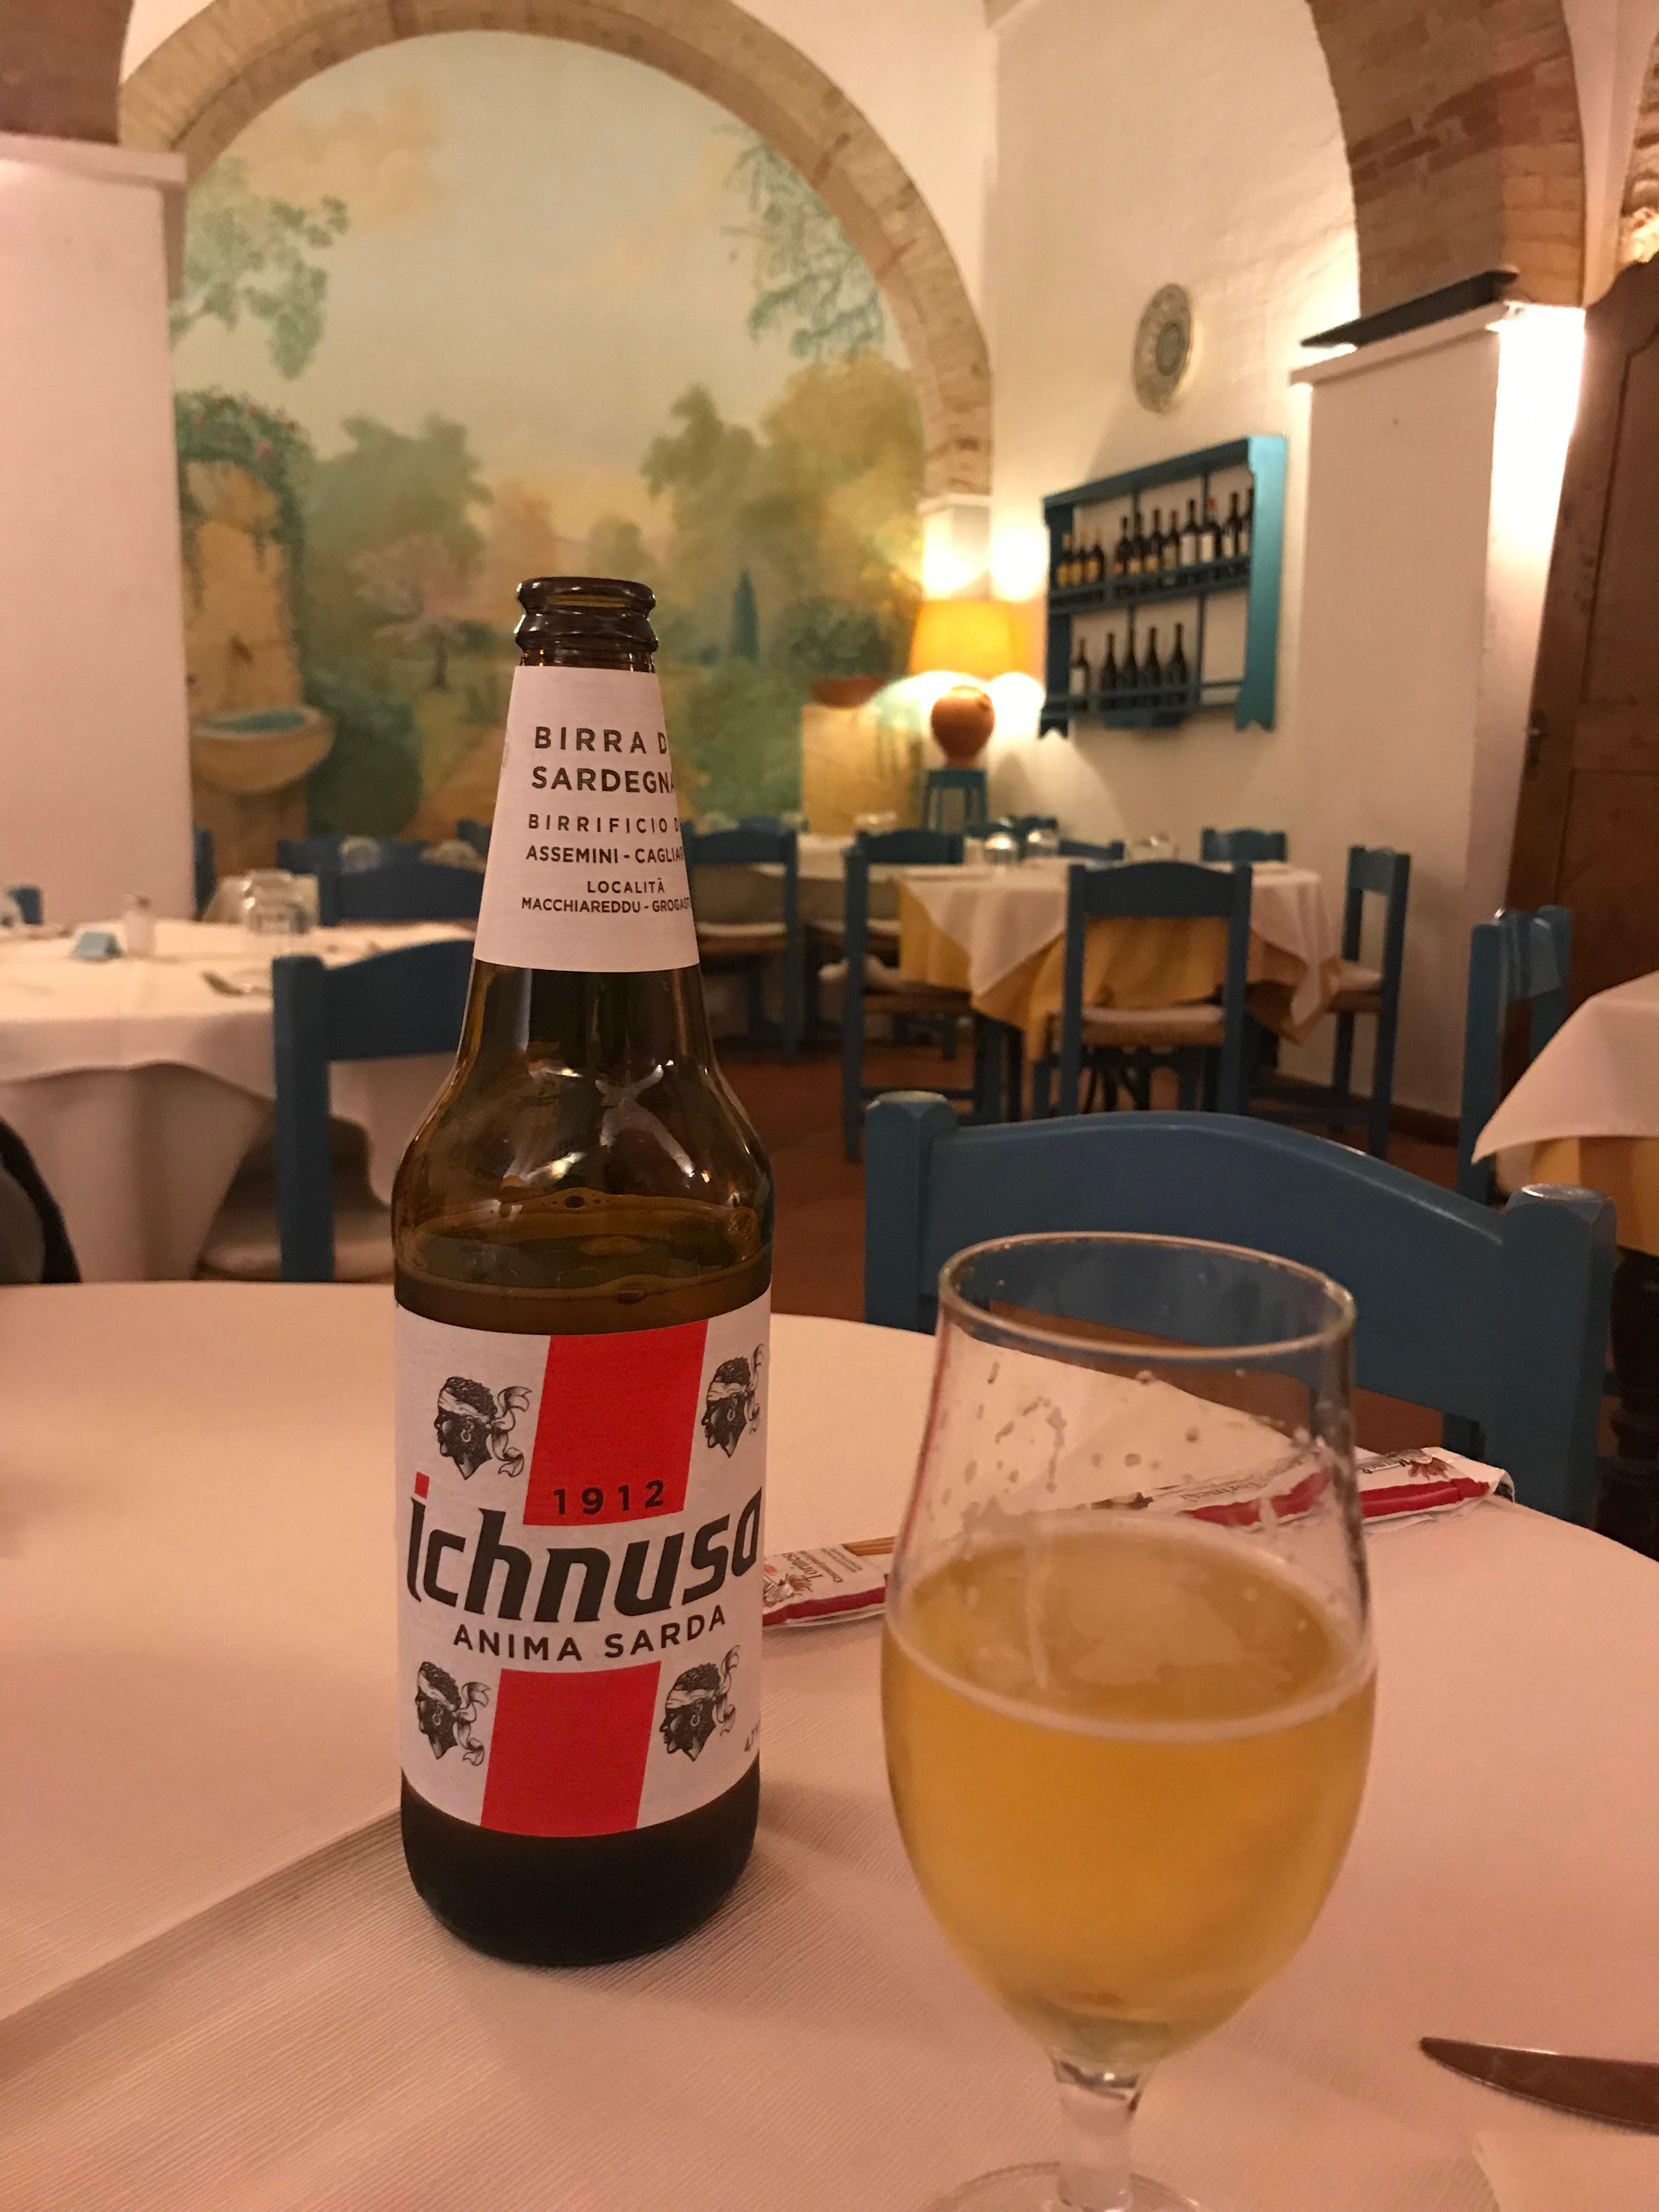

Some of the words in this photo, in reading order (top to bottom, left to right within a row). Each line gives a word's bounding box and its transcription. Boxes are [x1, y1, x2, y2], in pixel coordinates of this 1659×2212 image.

[535, 726, 646, 754] BIRRA
[528, 814, 668, 833] BIRRIFICIO
[526, 845, 618, 864] ASSEMINI
[587, 877, 665, 894] LOCALITÀ
[522, 897, 641, 913] MACCHIAREDDU
[554, 1480, 665, 1515] 1912
[407, 1471, 763, 1622] ichnusa
[453, 1624, 583, 1661] ANIMA
[605, 1604, 726, 1659] SARDA
